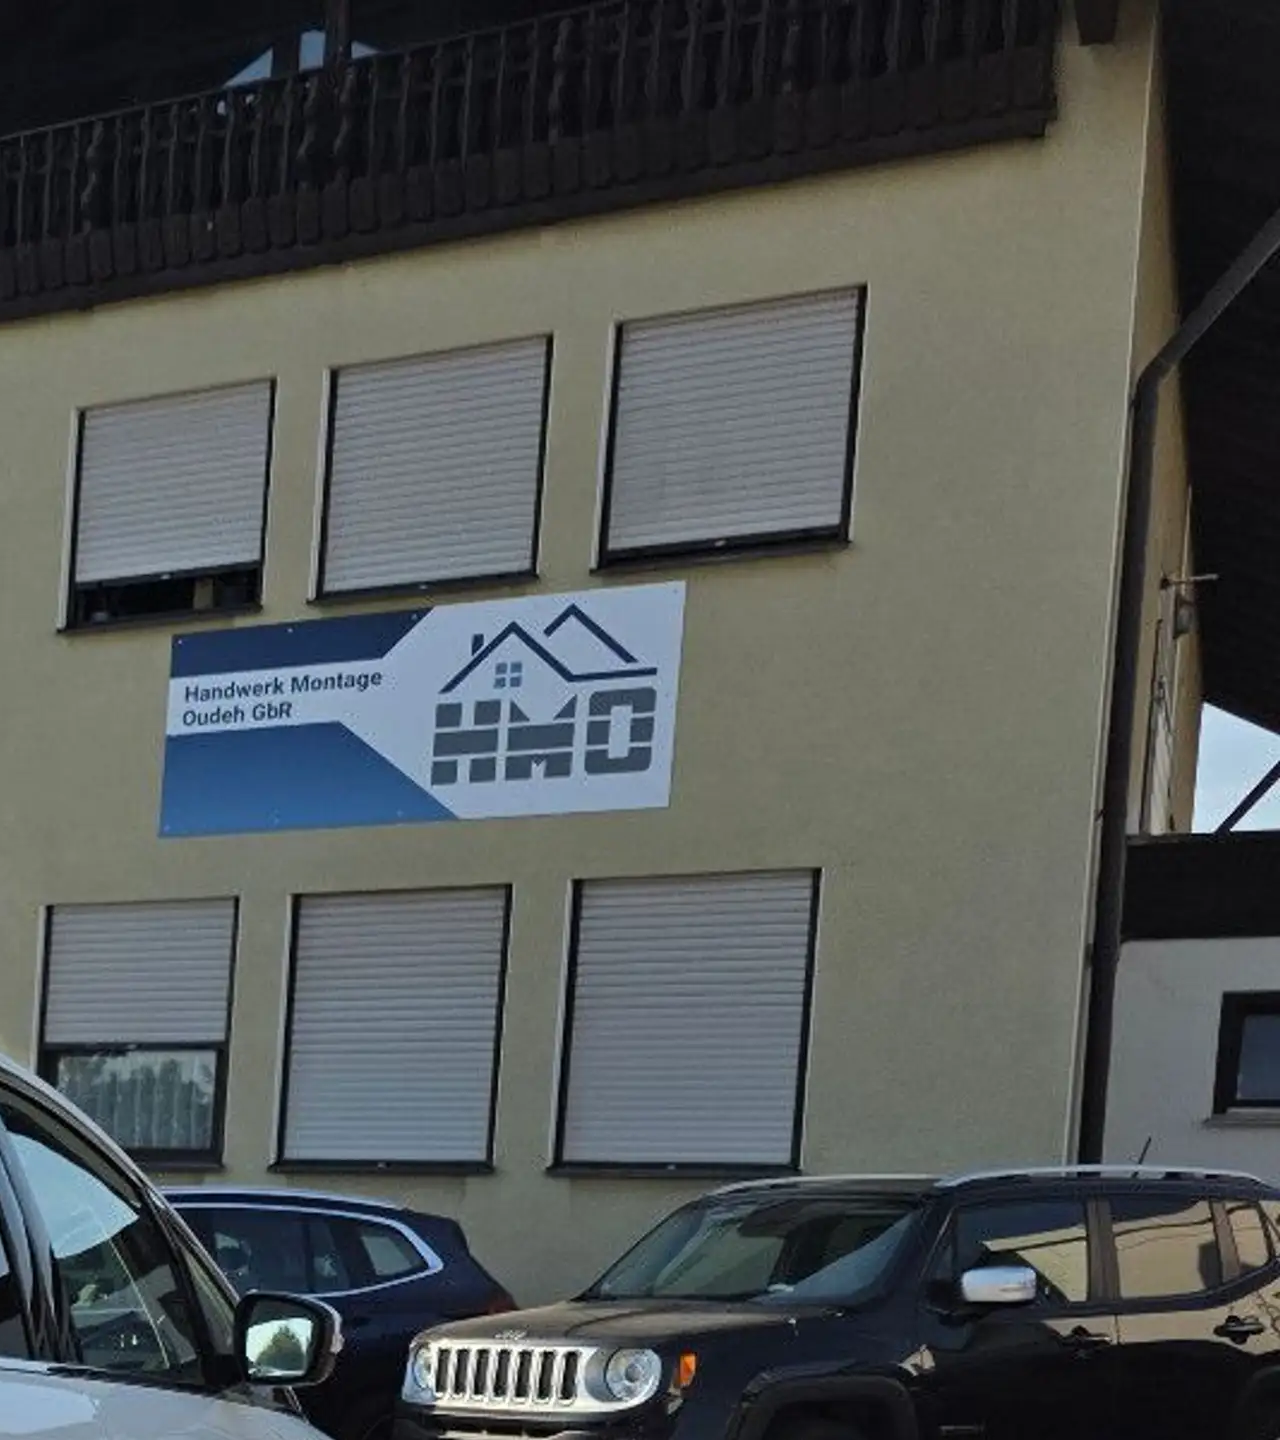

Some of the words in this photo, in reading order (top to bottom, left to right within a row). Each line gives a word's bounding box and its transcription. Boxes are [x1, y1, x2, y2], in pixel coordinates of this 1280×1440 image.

[184, 676, 285, 703] Handwerk
[290, 671, 383, 693] Montage
[182, 707, 246, 727] Oudeh
[252, 701, 293, 721] GbR
[430, 686, 658, 786] HMO
